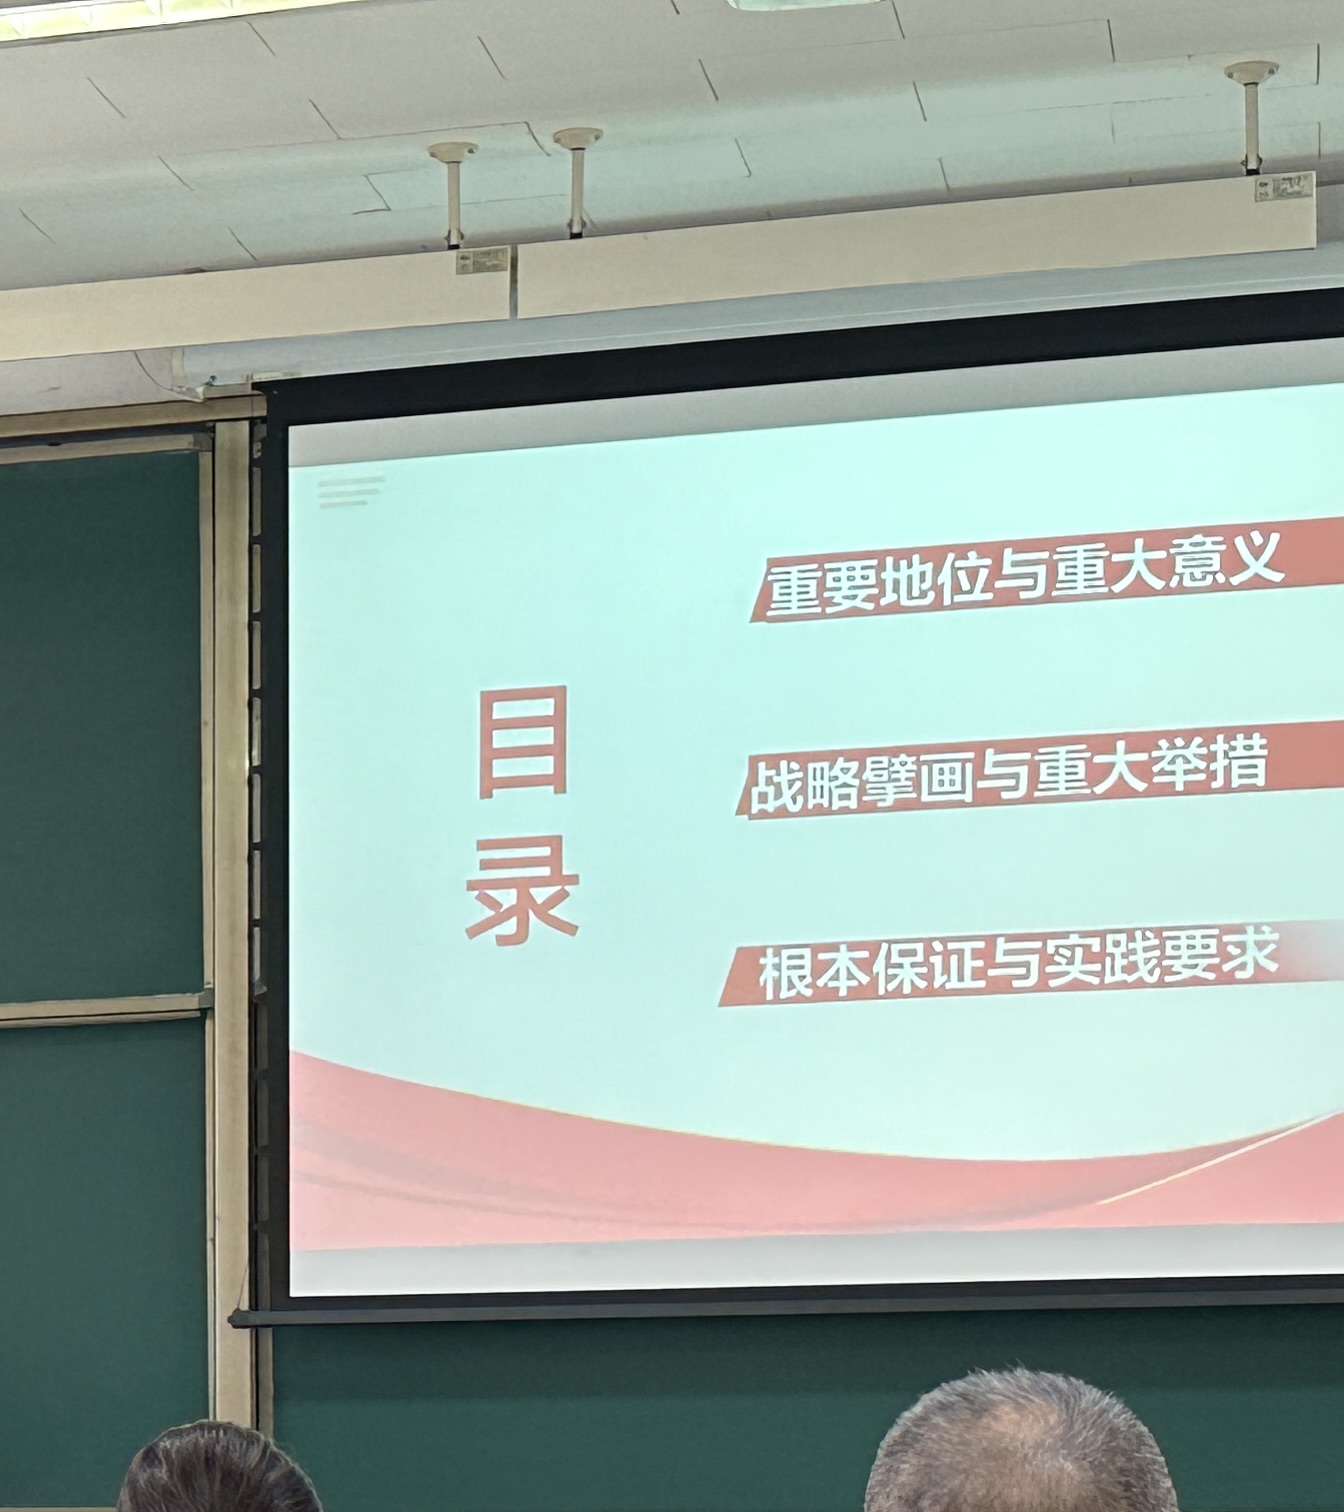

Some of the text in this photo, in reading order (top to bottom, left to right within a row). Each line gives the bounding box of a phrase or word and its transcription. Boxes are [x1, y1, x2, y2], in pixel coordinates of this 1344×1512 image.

[766, 530, 1286, 617] 重要地位与重大意义
[465, 685, 580, 946] 目录
[750, 733, 1269, 814] 战略擘画与重大举措
[759, 925, 1280, 1000] 根本保证与实践要求
